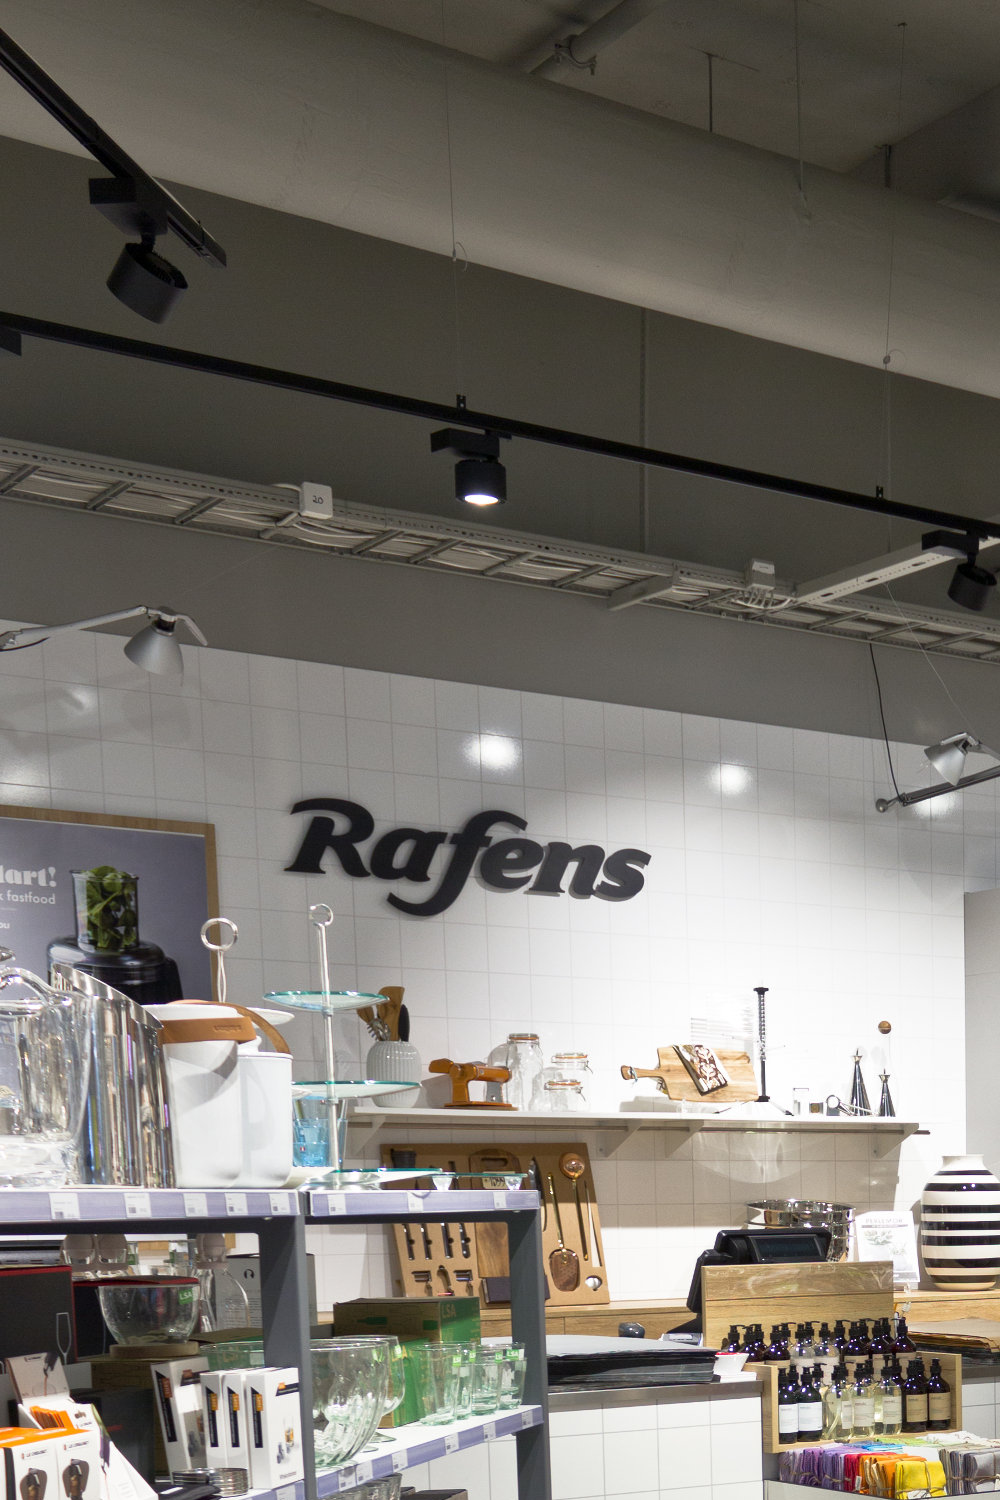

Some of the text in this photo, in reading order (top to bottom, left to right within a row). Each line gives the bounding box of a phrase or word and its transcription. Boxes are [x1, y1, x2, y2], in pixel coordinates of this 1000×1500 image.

[284, 798, 651, 916] Rafens
[7, 889, 56, 905] fastfood
[179, 1290, 193, 1300] LSA
